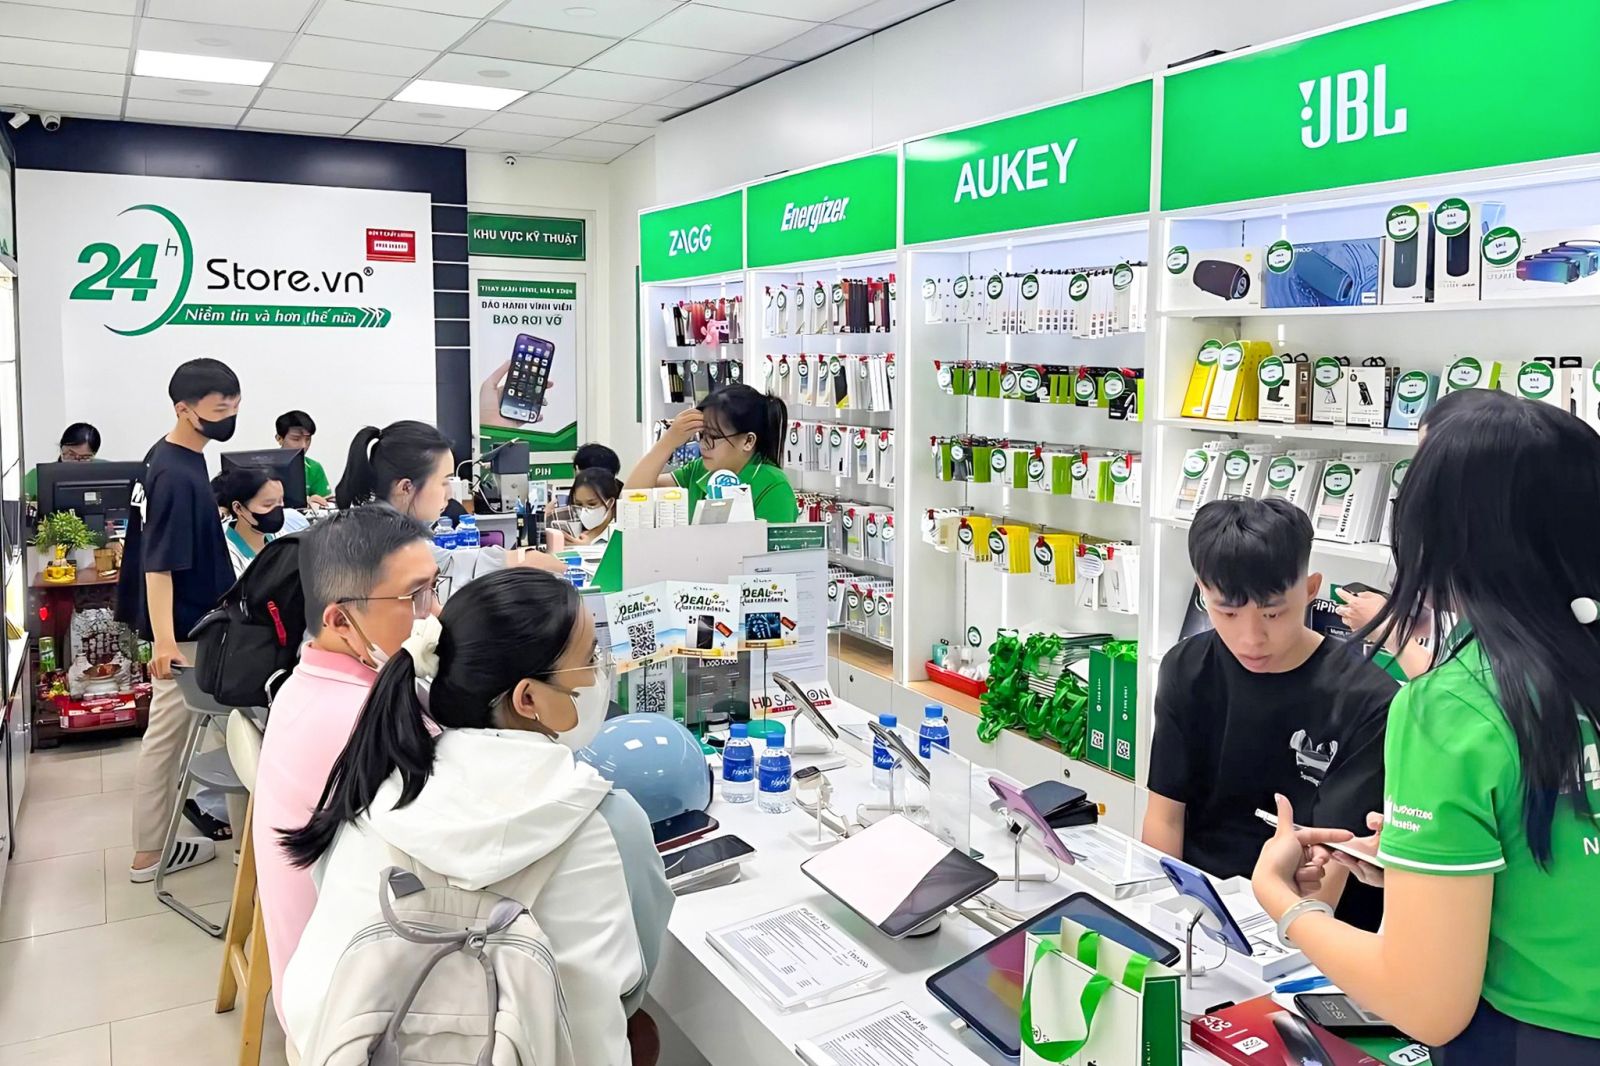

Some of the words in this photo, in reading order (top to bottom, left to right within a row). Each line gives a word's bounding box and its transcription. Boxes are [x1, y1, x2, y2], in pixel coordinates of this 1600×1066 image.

[1299, 63, 1407, 149] JBL
[953, 137, 1078, 203] AUKEY
[780, 196, 850, 233] Energizer
[473, 228, 497, 240] KHU
[499, 229, 523, 243] VỰC
[525, 229, 541, 243] KỸ
[543, 232, 578, 246] THUẬT
[668, 224, 712, 257] ZAGG
[70, 242, 159, 302] 24
[164, 238, 178, 257] h
[184, 306, 226, 322] Niềm
[229, 308, 249, 322] tin
[254, 309, 270, 322] và
[274, 309, 300, 323] hơn
[304, 309, 329, 324] thế
[331, 311, 356, 324] nữa
[493, 314, 518, 325] BAO
[522, 315, 542, 325] RƠI
[680, 594, 711, 606] DEAL
[742, 587, 771, 598] DEAL
[619, 601, 645, 616] DEAL
[1316, 601, 1336, 613] iPh
[752, 696, 773, 709] HD
[774, 688, 830, 707] SAON
